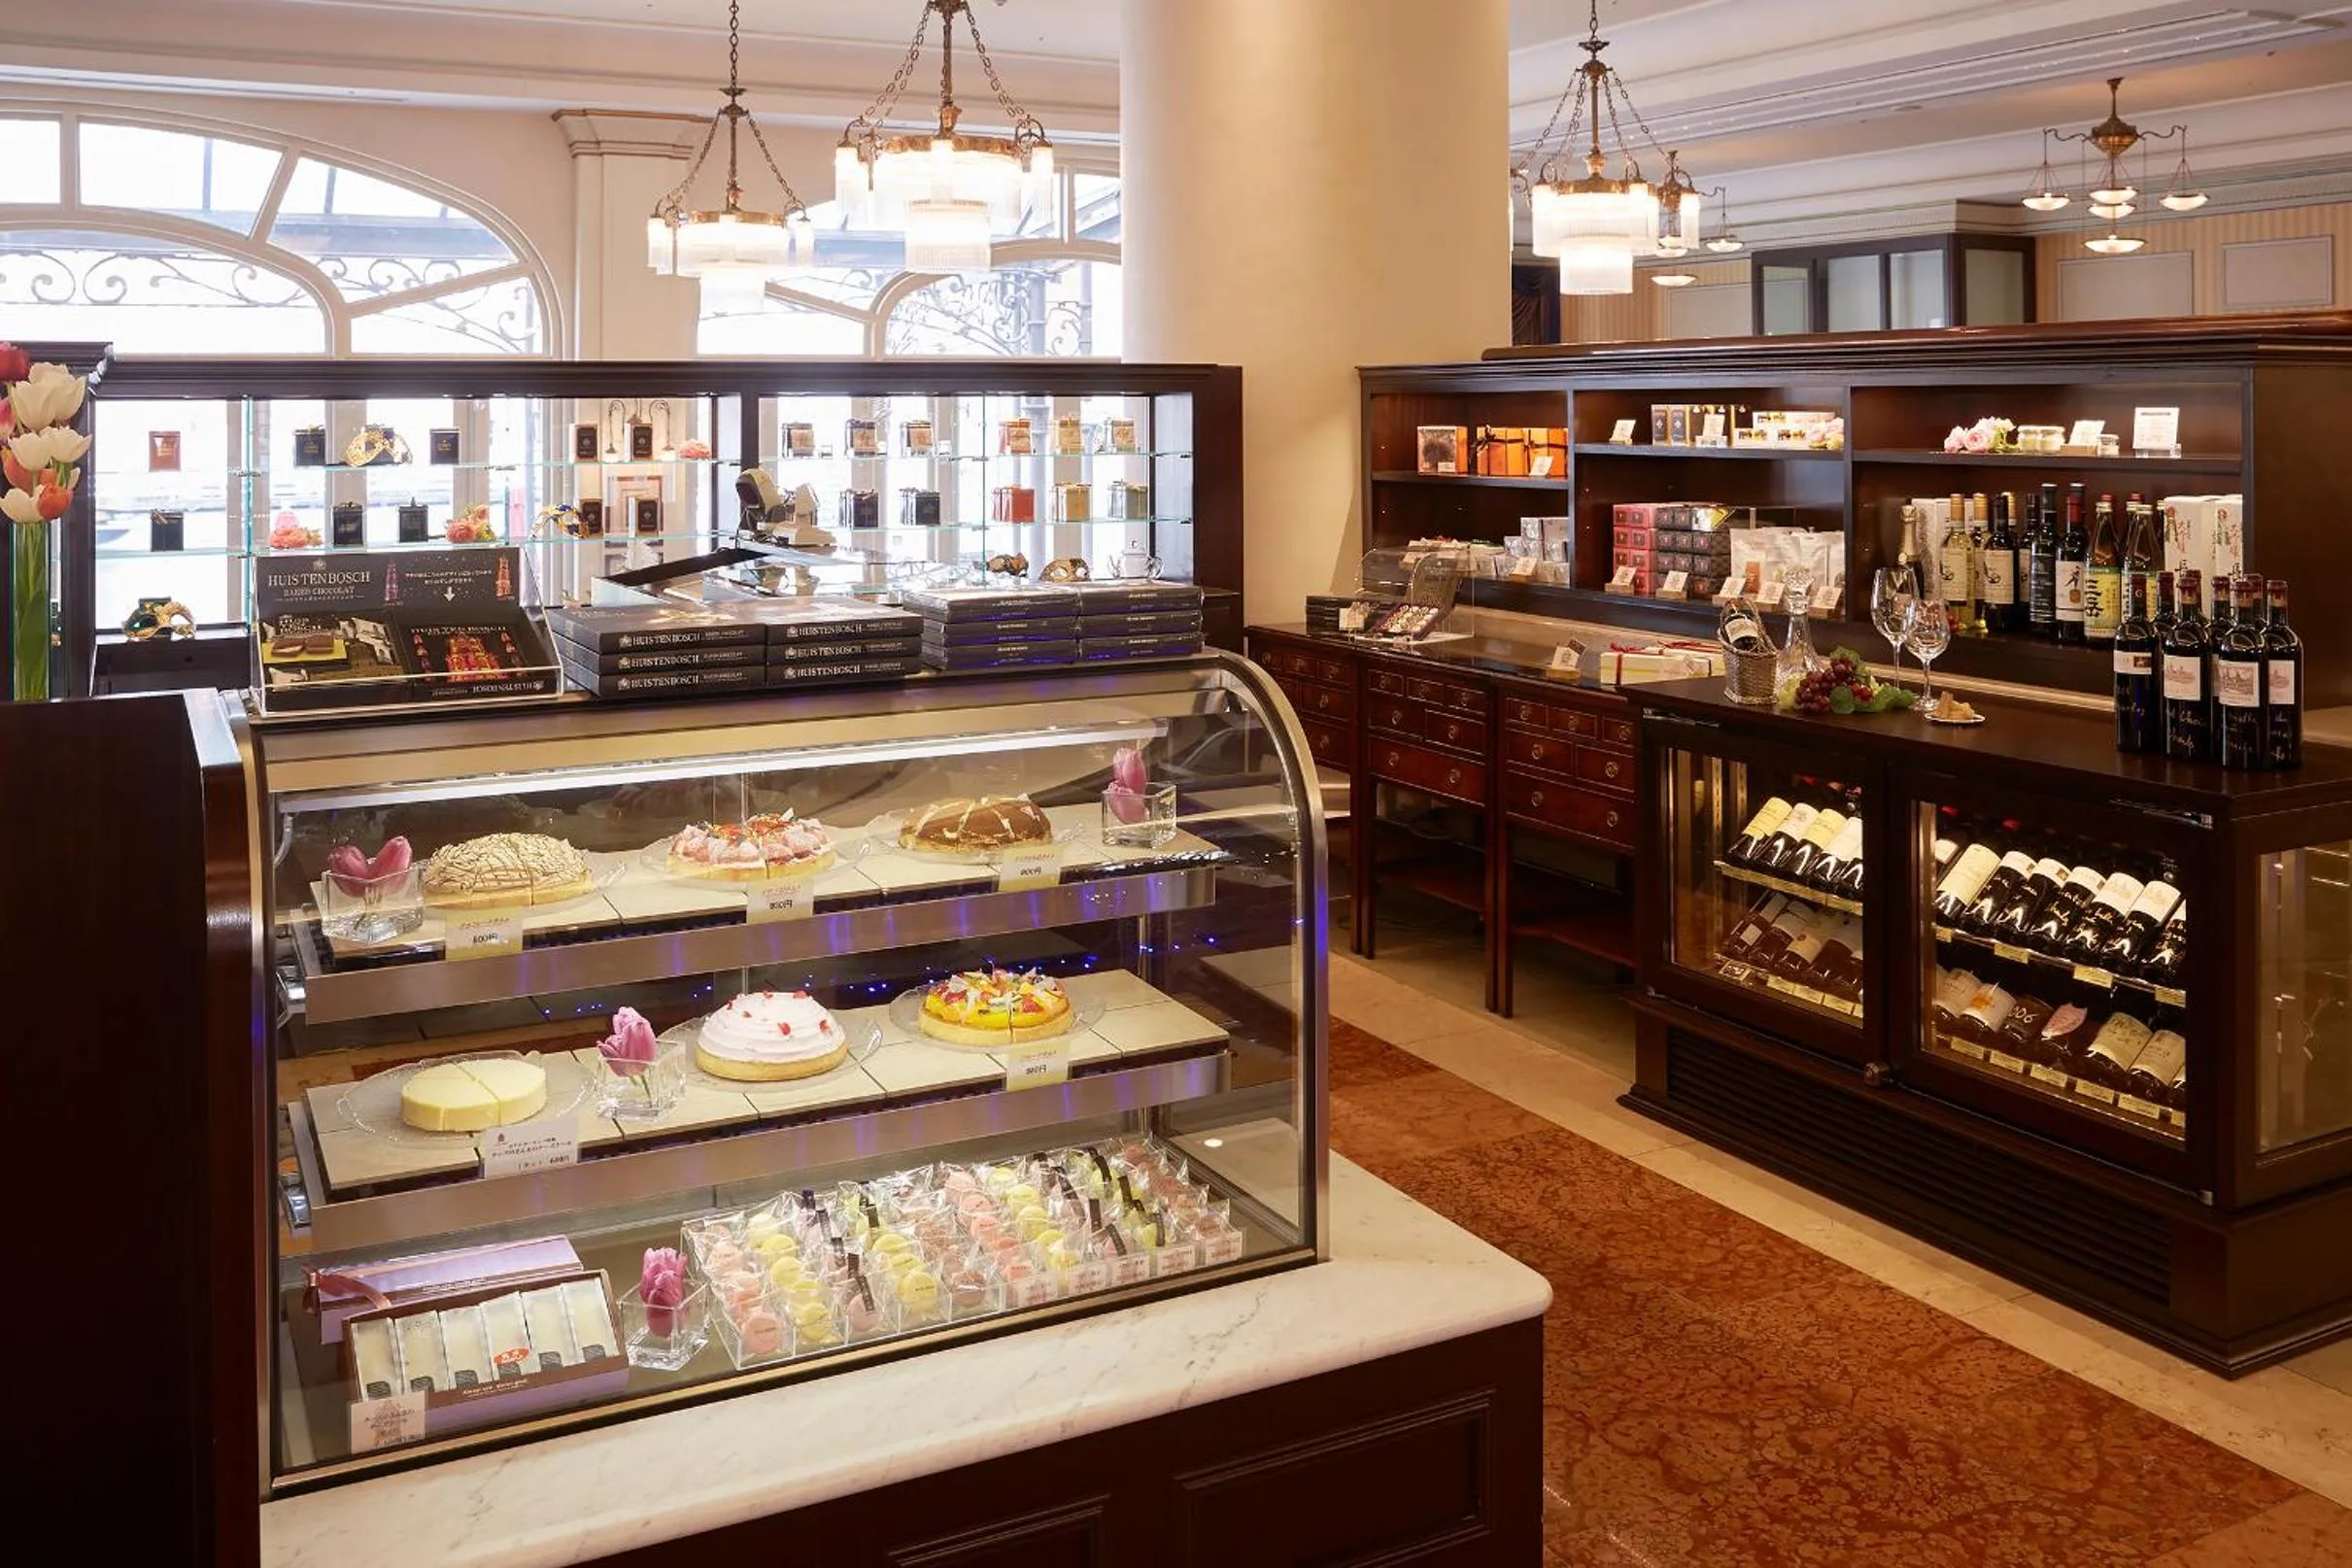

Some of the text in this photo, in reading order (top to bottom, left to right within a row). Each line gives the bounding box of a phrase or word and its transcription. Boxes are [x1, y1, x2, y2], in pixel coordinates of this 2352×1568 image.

[268, 571, 370, 587] HUIS TEN BOSCH
